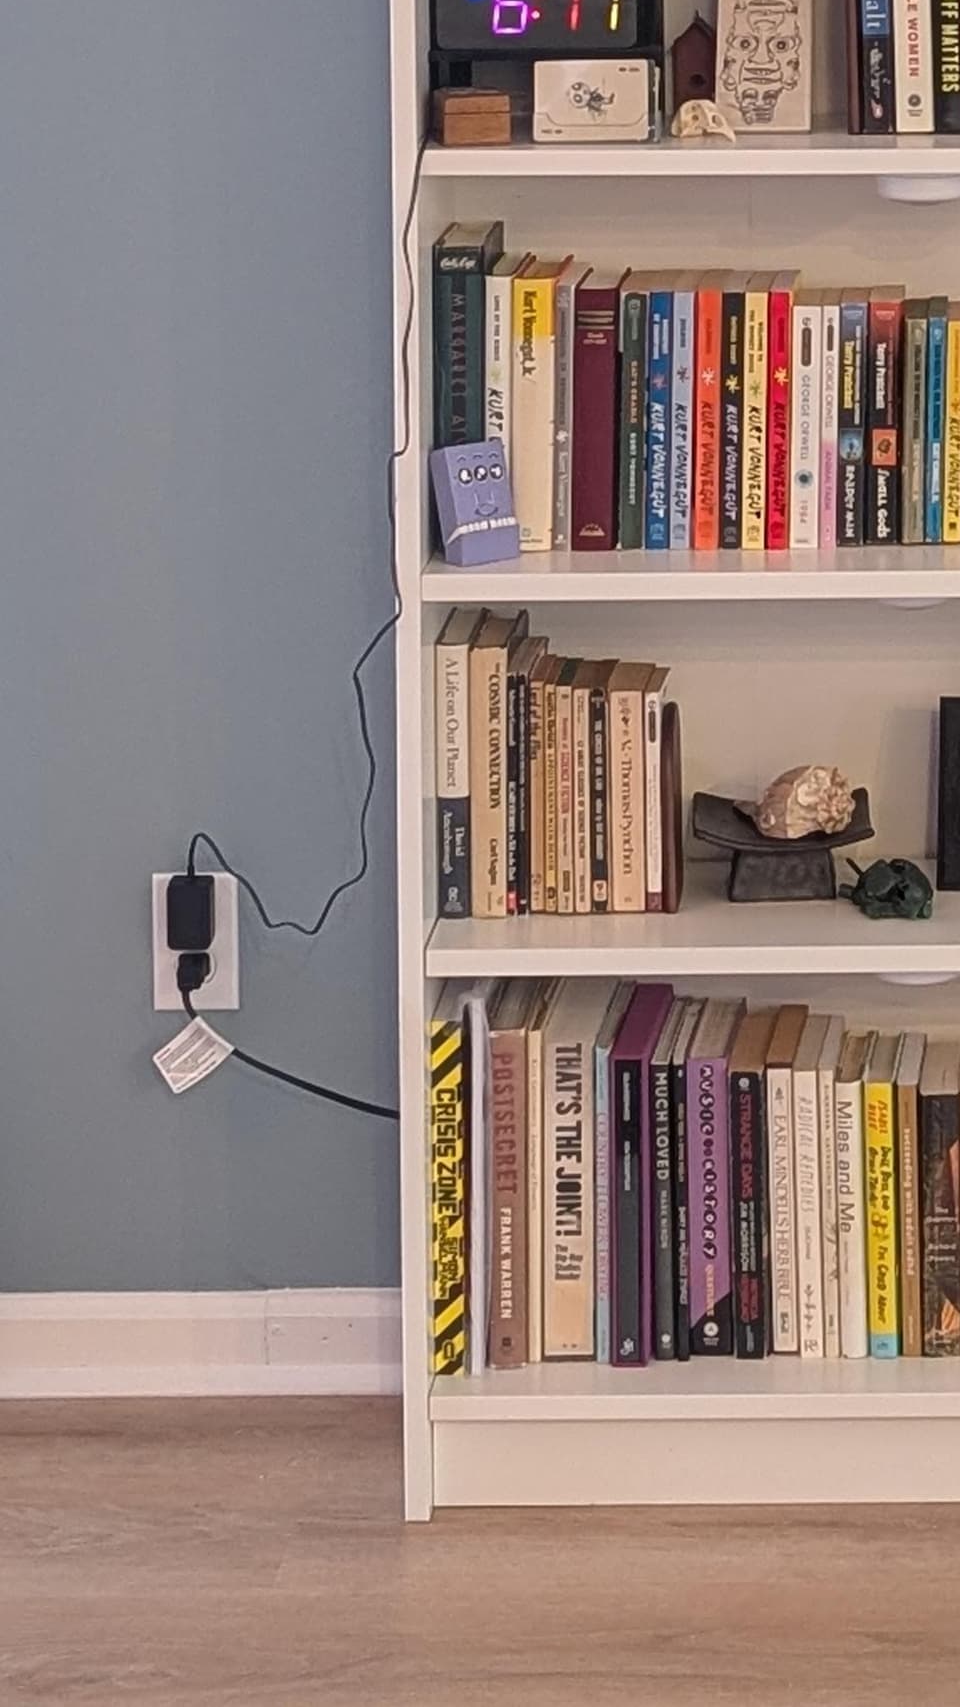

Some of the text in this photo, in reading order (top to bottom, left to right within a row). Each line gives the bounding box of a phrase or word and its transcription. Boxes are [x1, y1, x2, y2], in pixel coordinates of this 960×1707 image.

[907, 17, 919, 77] WOMEN
[942, 23, 960, 93] MATTERS
[450, 293, 466, 395] MARGARET
[487, 387, 504, 432] KURT
[650, 402, 666, 518] KURT VONNEGUT
[673, 402, 689, 518] KURT VONNEGUT
[700, 400, 715, 517] KURT VONNEGUT
[772, 401, 787, 518] KURT VONNEGUT
[724, 404, 738, 521] KURT VONNEGUT
[746, 404, 762, 520] KURT VONNEGUT
[947, 416, 960, 517] KURT VONNEGUT
[445, 657, 460, 787] A Life on Our Planet
[488, 675, 501, 724] COSMIC
[488, 728, 501, 809] CONNECTION
[621, 756, 634, 813] Thomas
[617, 814, 635, 876] Pynchon
[555, 1042, 582, 1116] THAT'S
[655, 1072, 670, 1181] MUCH LOVED
[699, 1064, 714, 1136] MUSIC
[436, 1088, 458, 1216] CRISIS ZONE
[555, 1120, 582, 1164] THE
[739, 1093, 753, 1199] STRANGE DAYS
[774, 1114, 788, 1150] EARL
[837, 1100, 856, 1233] Miles and Me
[493, 1054, 518, 1319] POSTSECRET FRANK WARREN
[555, 1166, 582, 1237] JOINT!
[447, 1237, 458, 1282] SIMON
